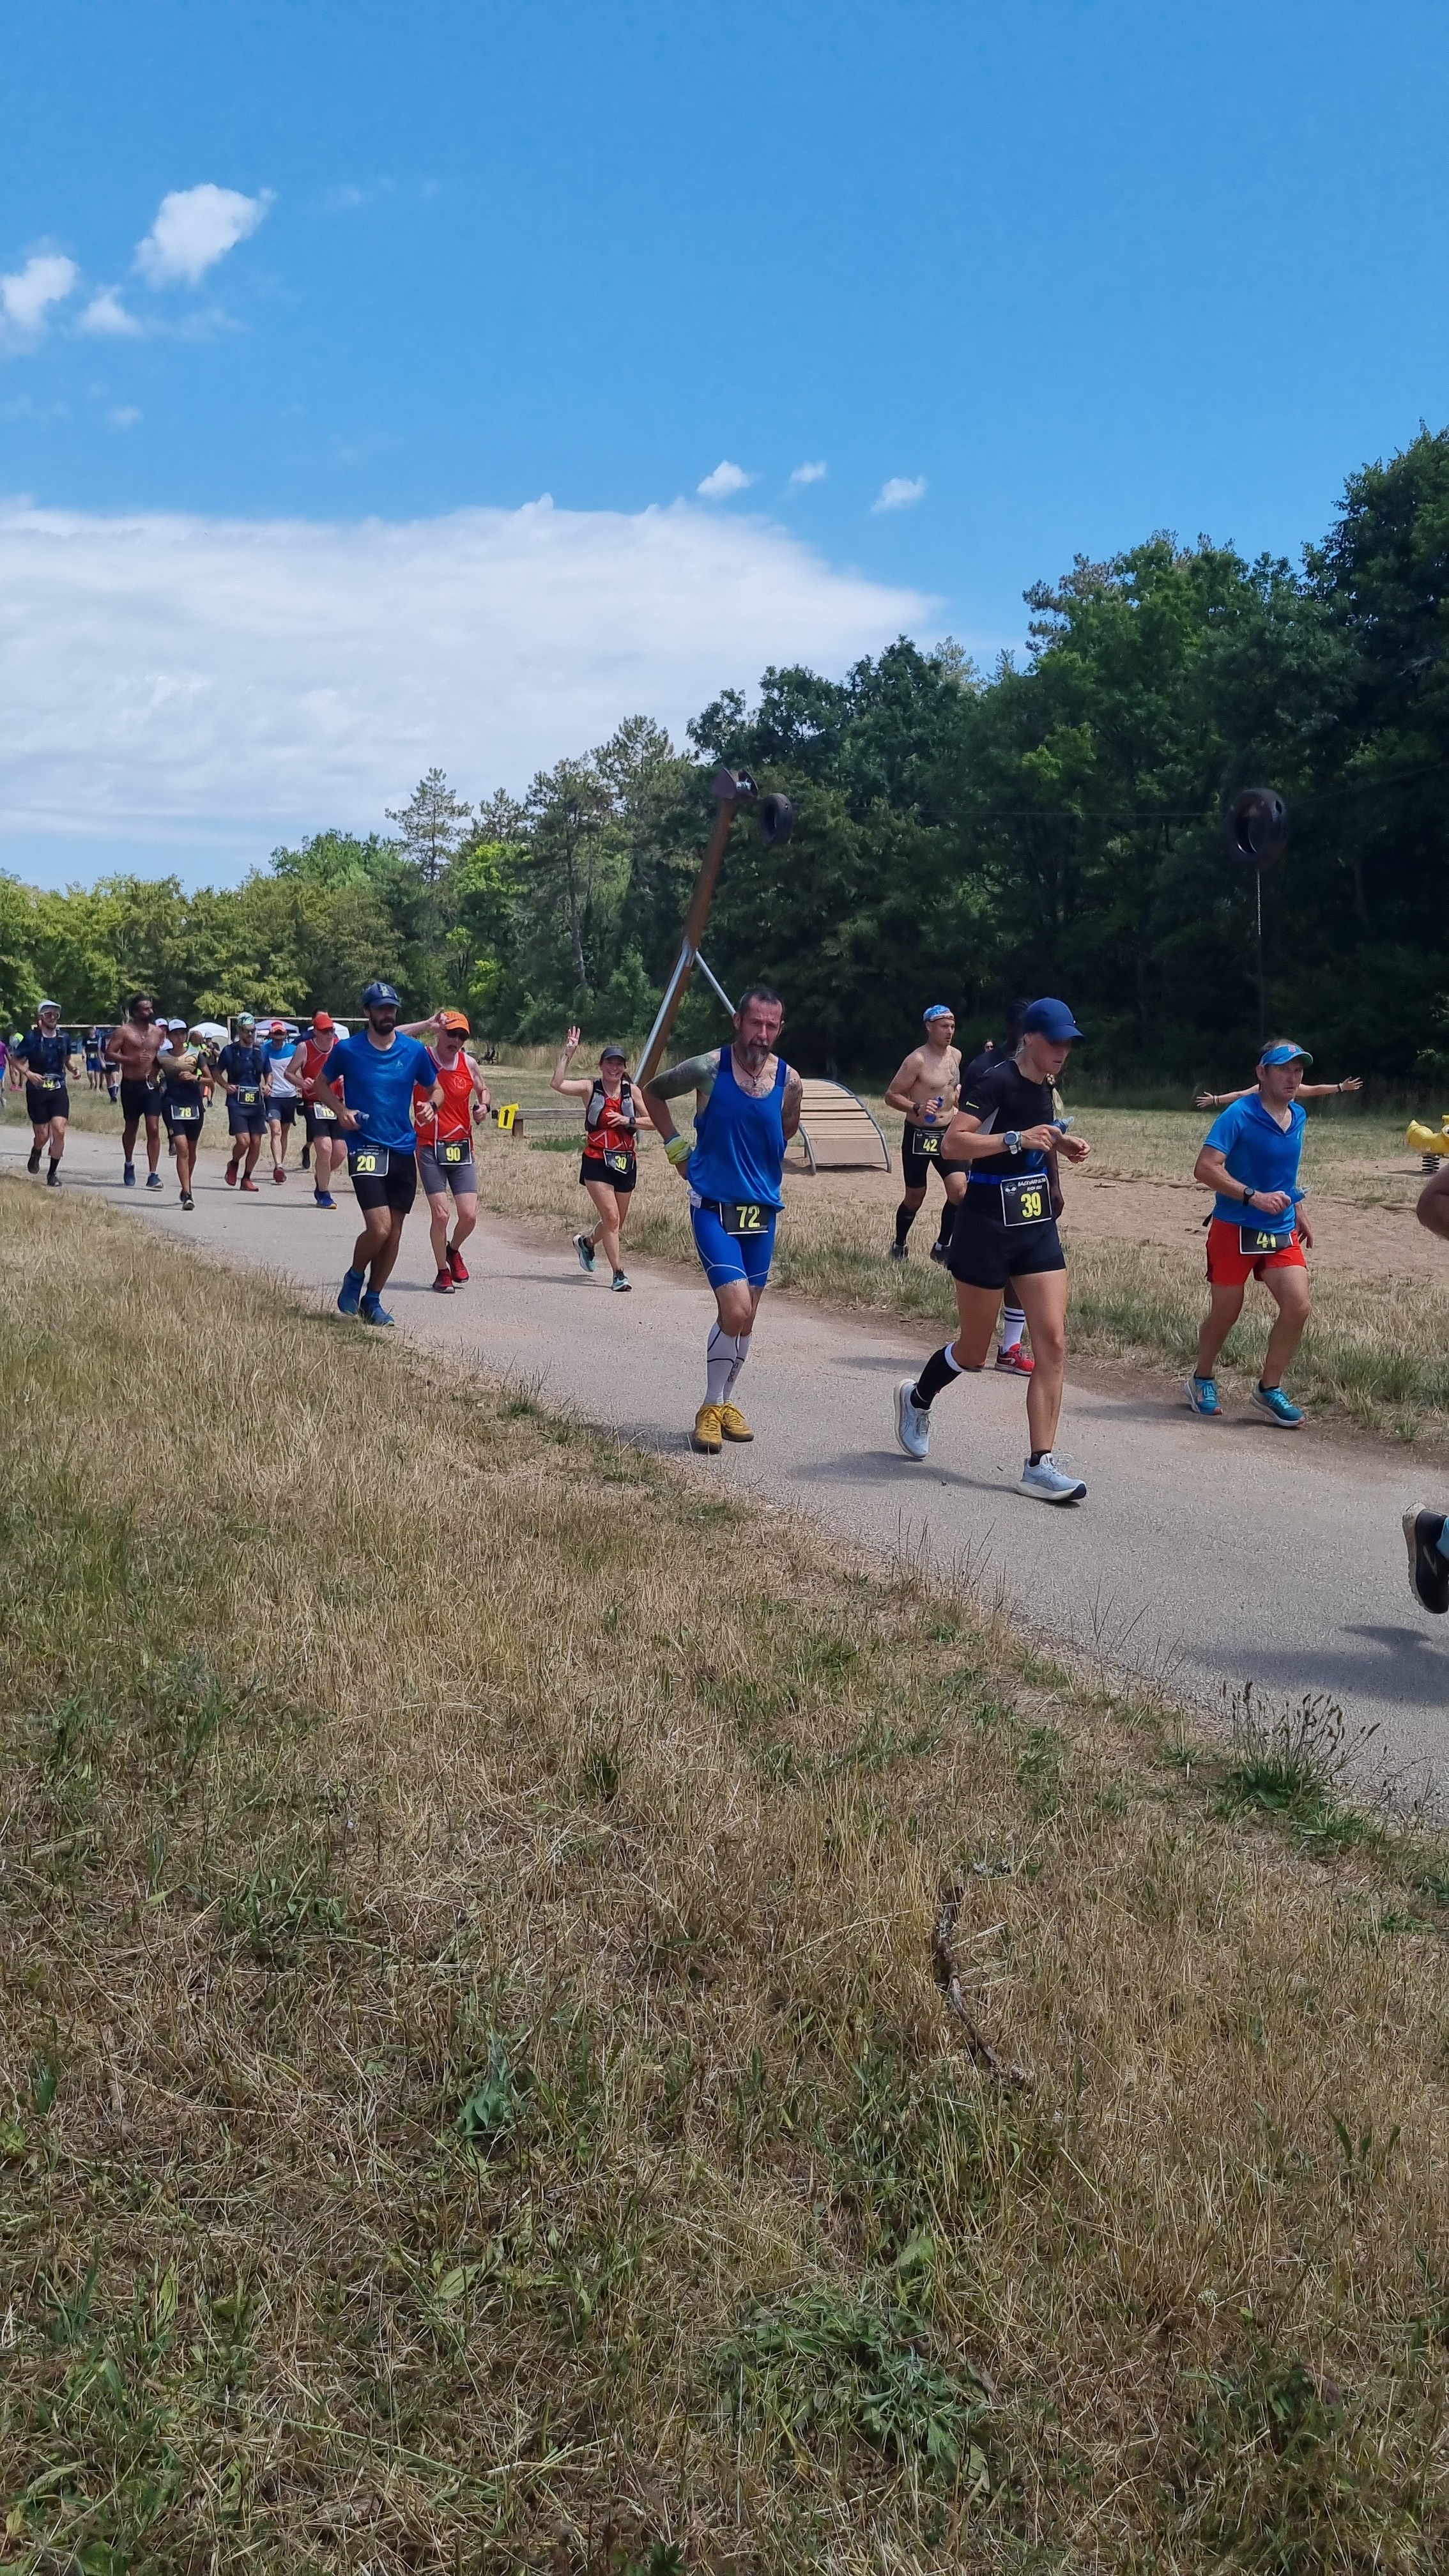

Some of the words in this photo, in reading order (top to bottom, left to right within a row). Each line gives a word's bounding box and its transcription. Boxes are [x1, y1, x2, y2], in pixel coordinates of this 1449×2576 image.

[245, 1092, 255, 1103] 85
[180, 1107, 192, 1117] 78
[923, 1138, 938, 1152] 42
[446, 1147, 461, 1162] 90
[356, 1155, 376, 1172] 20
[615, 1155, 627, 1170] 30
[1020, 1192, 1041, 1218] 39
[736, 1205, 760, 1228] 72
[1256, 1230, 1276, 1248] 41
